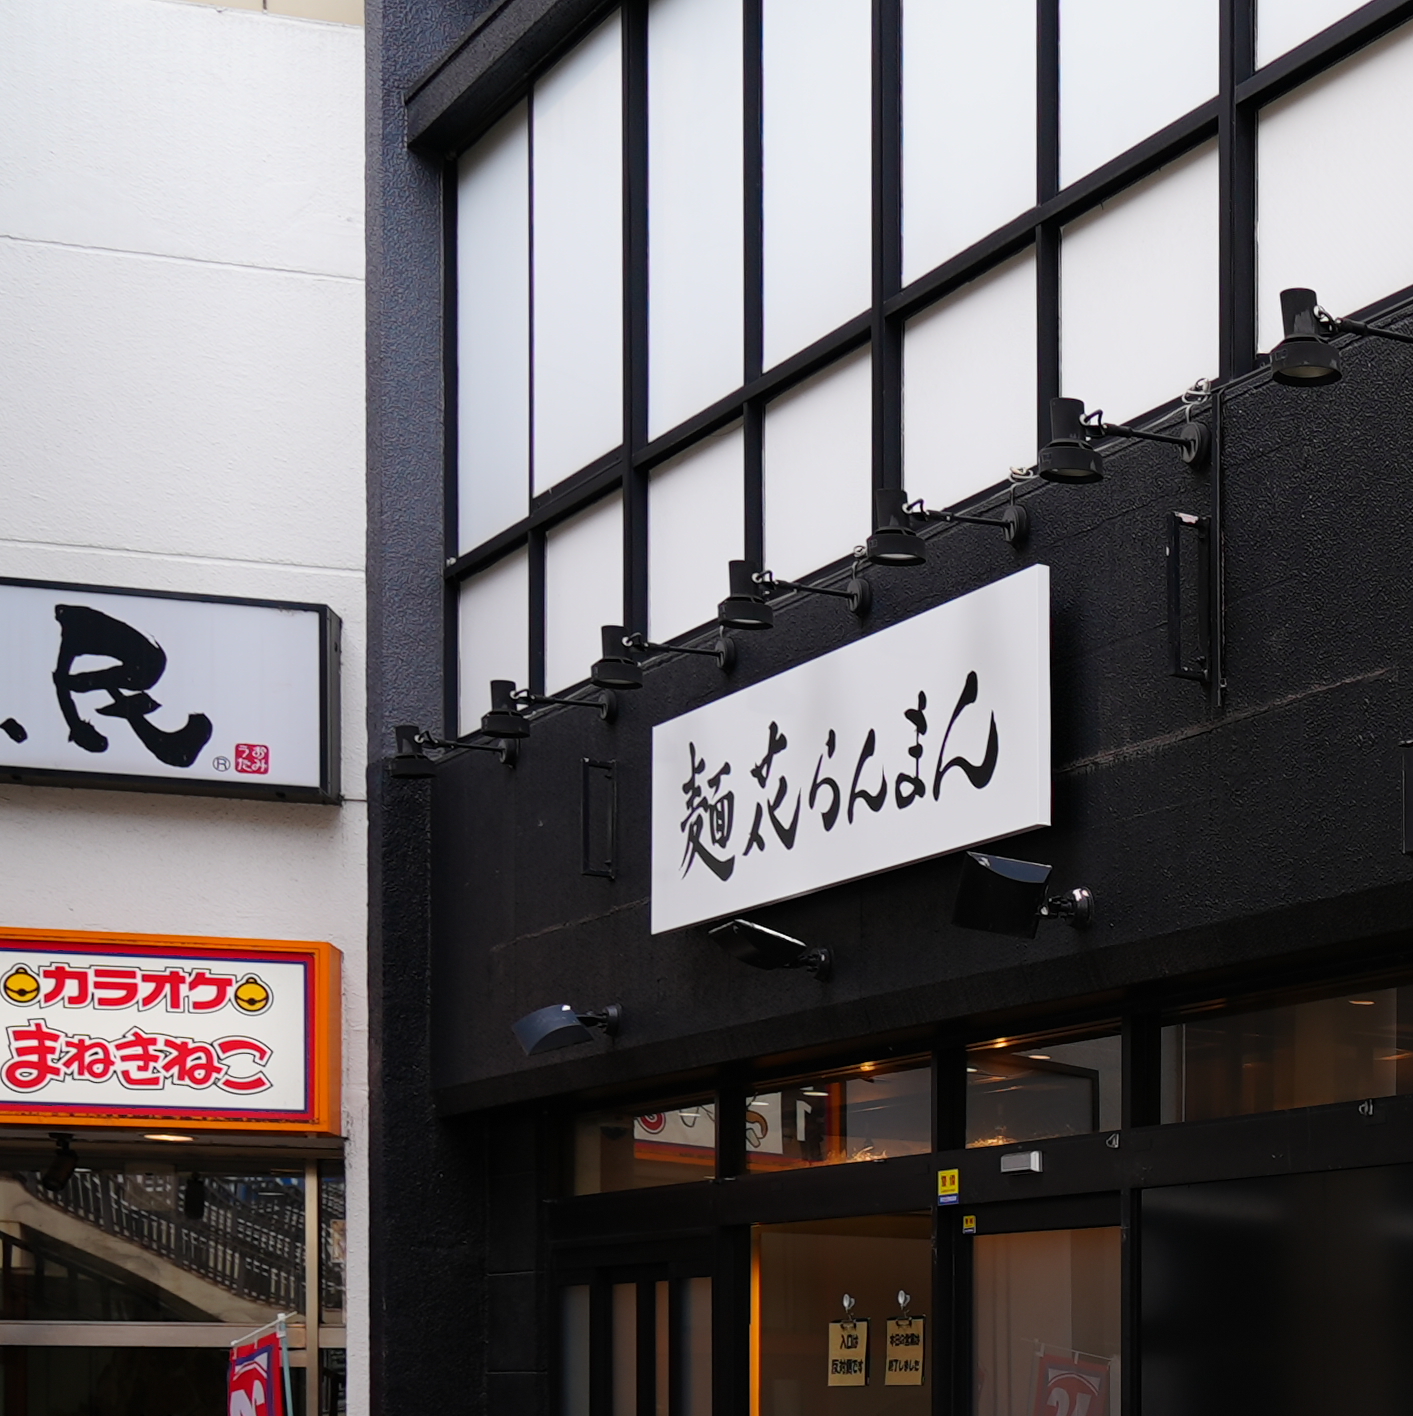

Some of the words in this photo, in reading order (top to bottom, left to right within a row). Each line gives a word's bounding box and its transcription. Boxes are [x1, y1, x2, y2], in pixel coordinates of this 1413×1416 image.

[0, 603, 213, 768] 民
[678, 669, 1000, 882] 麺花らんまん
[42, 967, 236, 1009] カラオケ
[4, 1020, 272, 1092] まねきねこ
